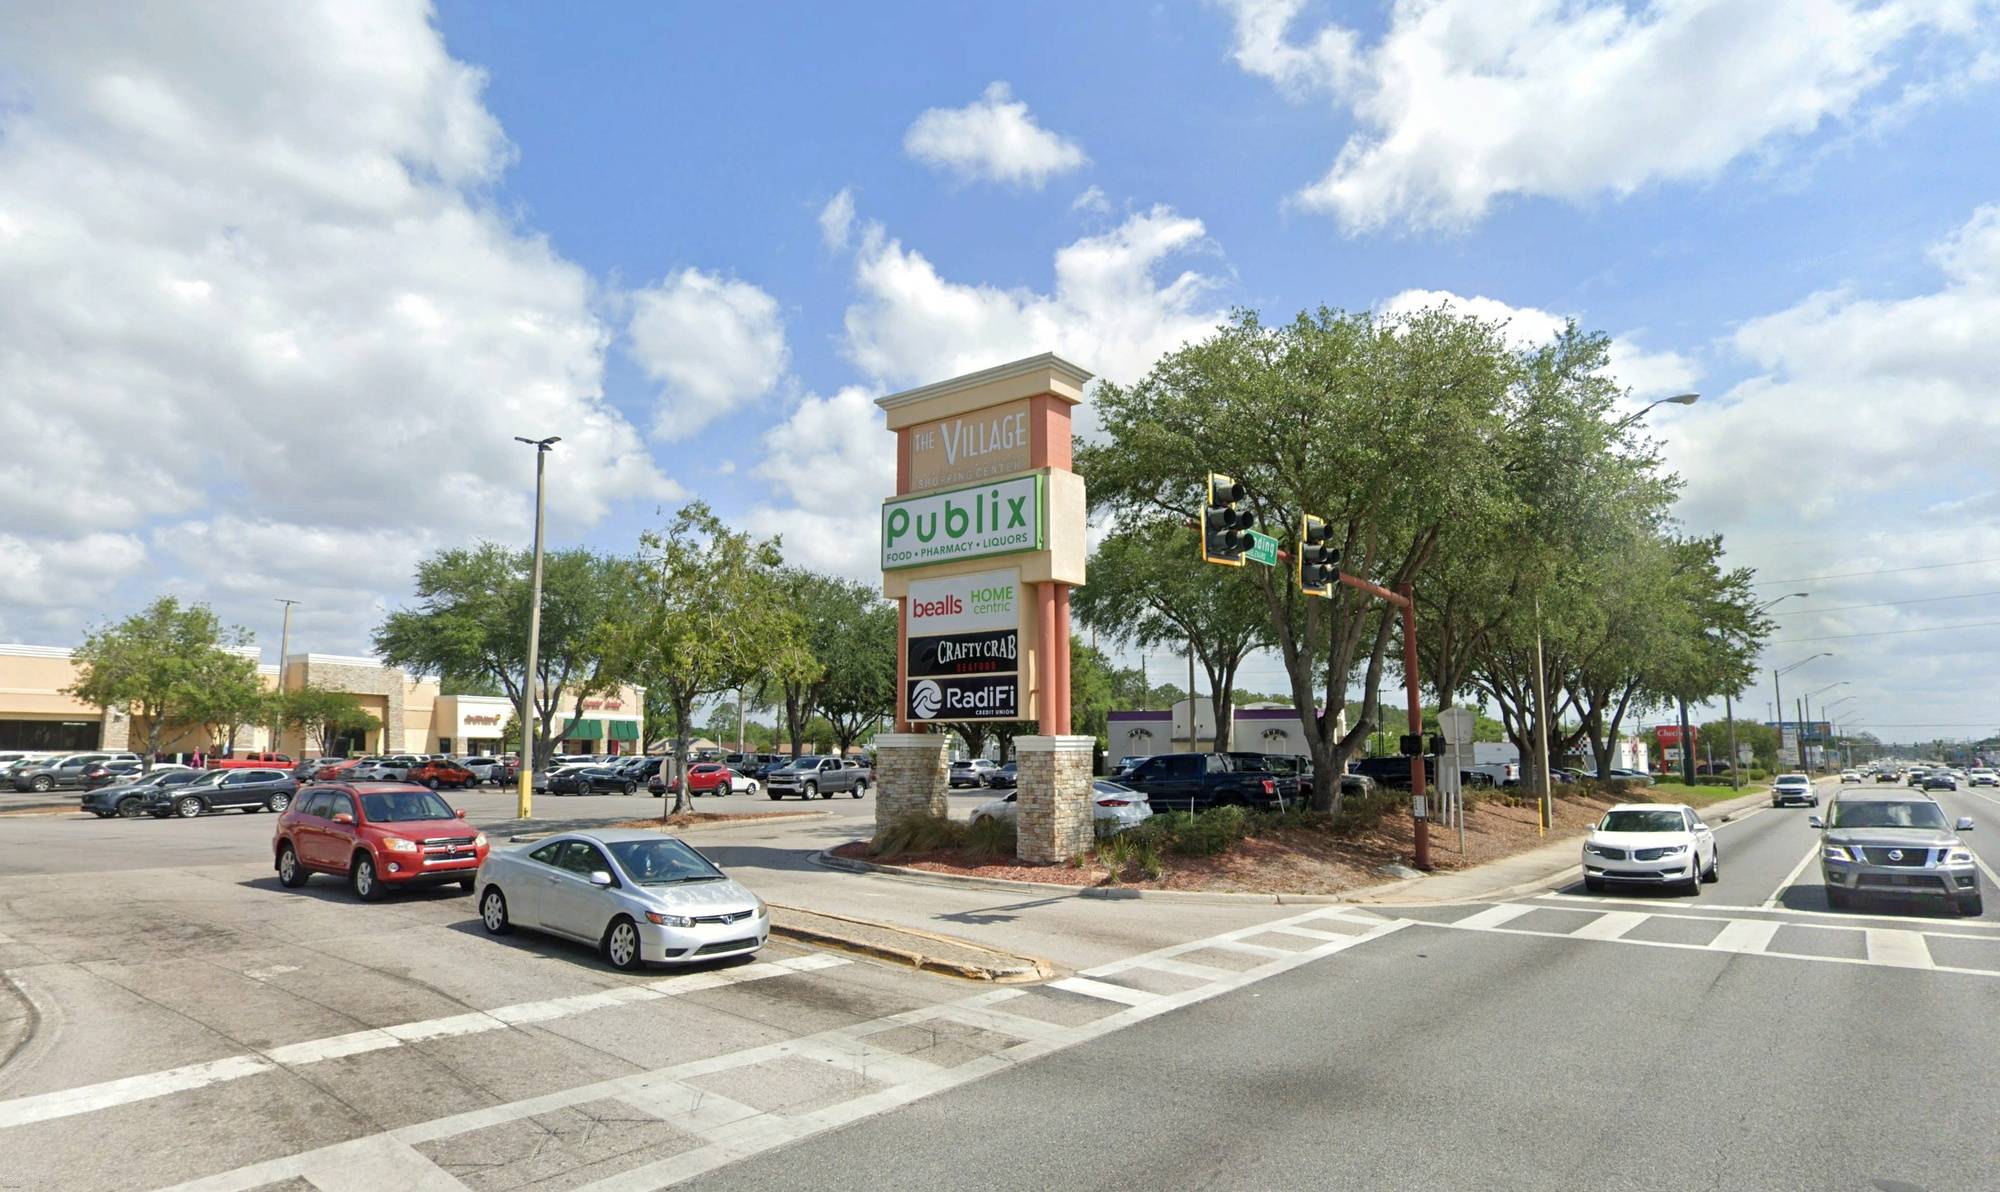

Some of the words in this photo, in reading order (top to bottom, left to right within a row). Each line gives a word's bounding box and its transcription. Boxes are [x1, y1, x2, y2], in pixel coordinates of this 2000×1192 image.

[914, 431, 935, 453] THE
[940, 412, 1027, 466] VILLAGE
[887, 489, 1027, 548] Publix
[886, 551, 912, 563] FOOD
[921, 541, 974, 558] PHARMACY
[983, 532, 1028, 549] LIQUORS
[913, 594, 963, 618] bealls
[971, 586, 1014, 604] HOME
[973, 602, 1011, 615] centric
[938, 640, 982, 664] CRAFTY
[984, 635, 1016, 660] CRAB
[946, 685, 1015, 709] RadiFi
